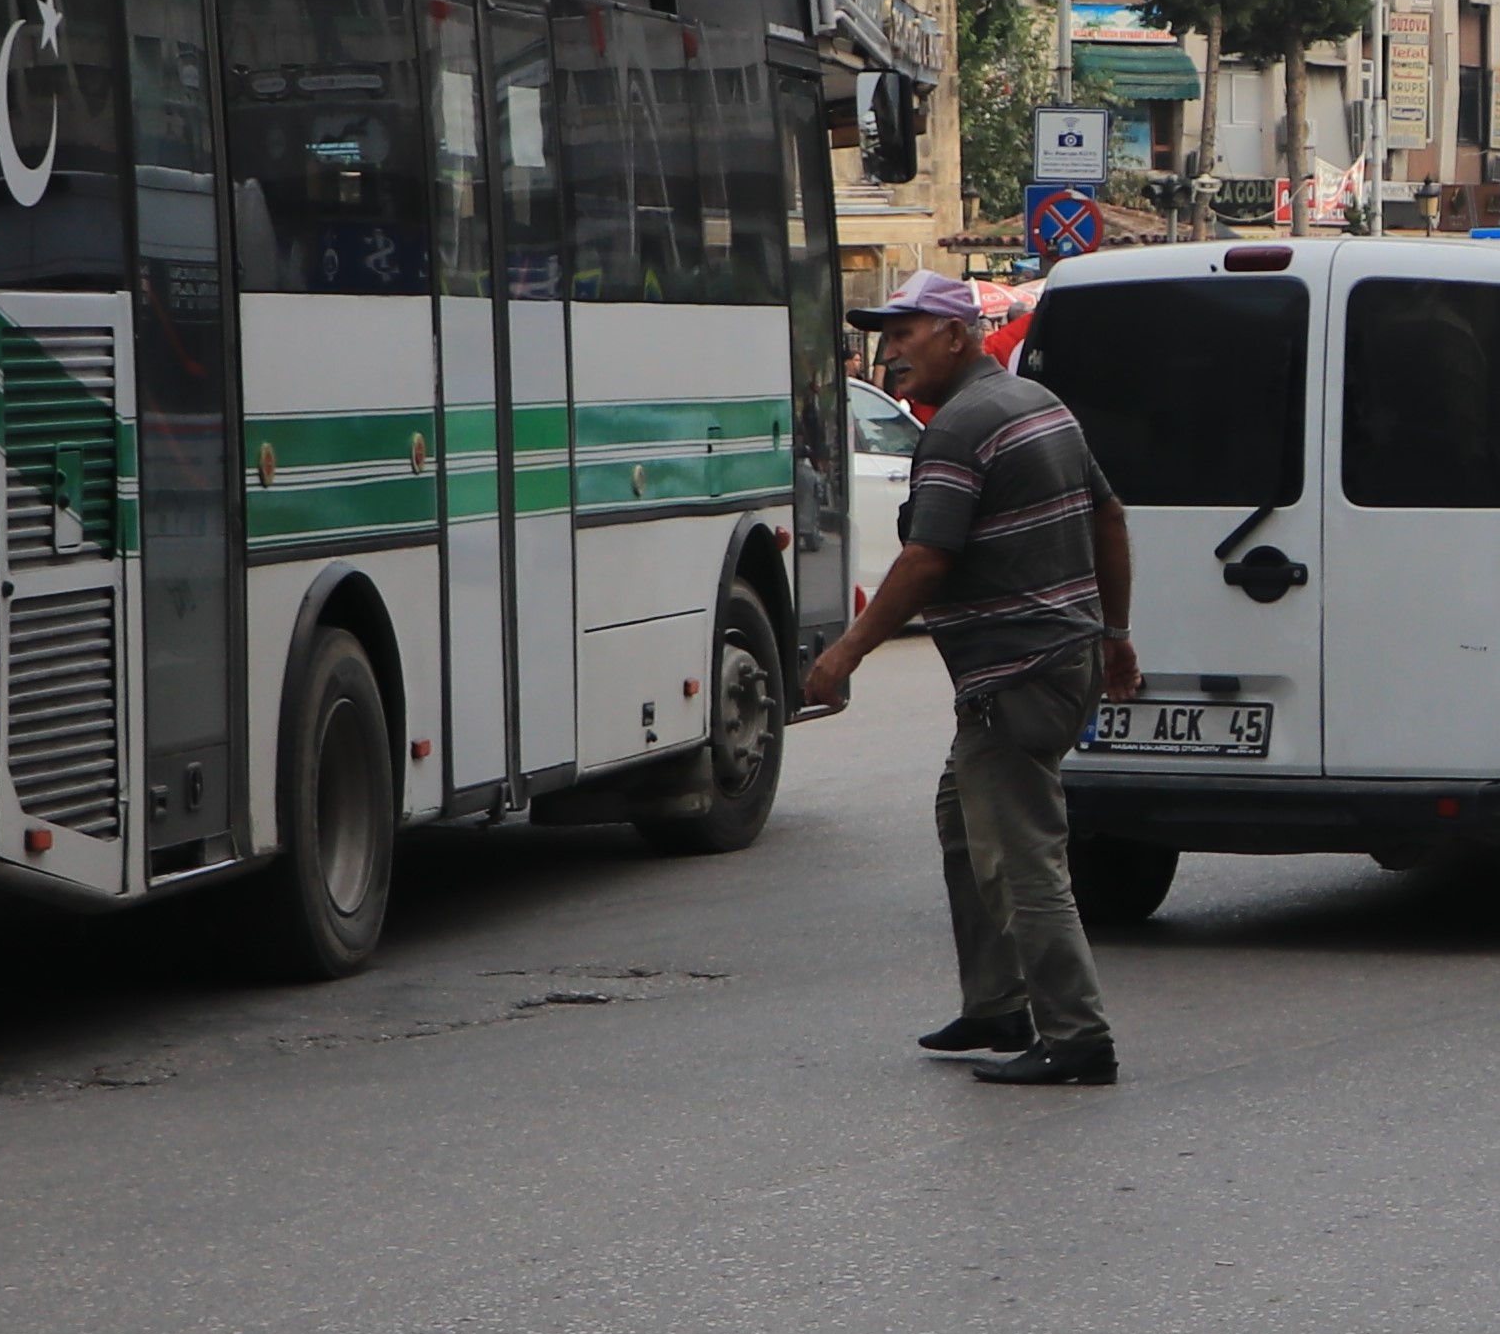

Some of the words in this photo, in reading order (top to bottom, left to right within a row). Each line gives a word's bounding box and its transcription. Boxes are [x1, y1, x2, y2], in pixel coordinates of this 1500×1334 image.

[1392, 47, 1427, 59] Tefal
[1391, 82, 1426, 93] KRUPS
[1235, 180, 1275, 204] GOLD
[1098, 706, 1132, 739] 33
[1153, 707, 1205, 741] ACK
[1229, 709, 1264, 743] 45
